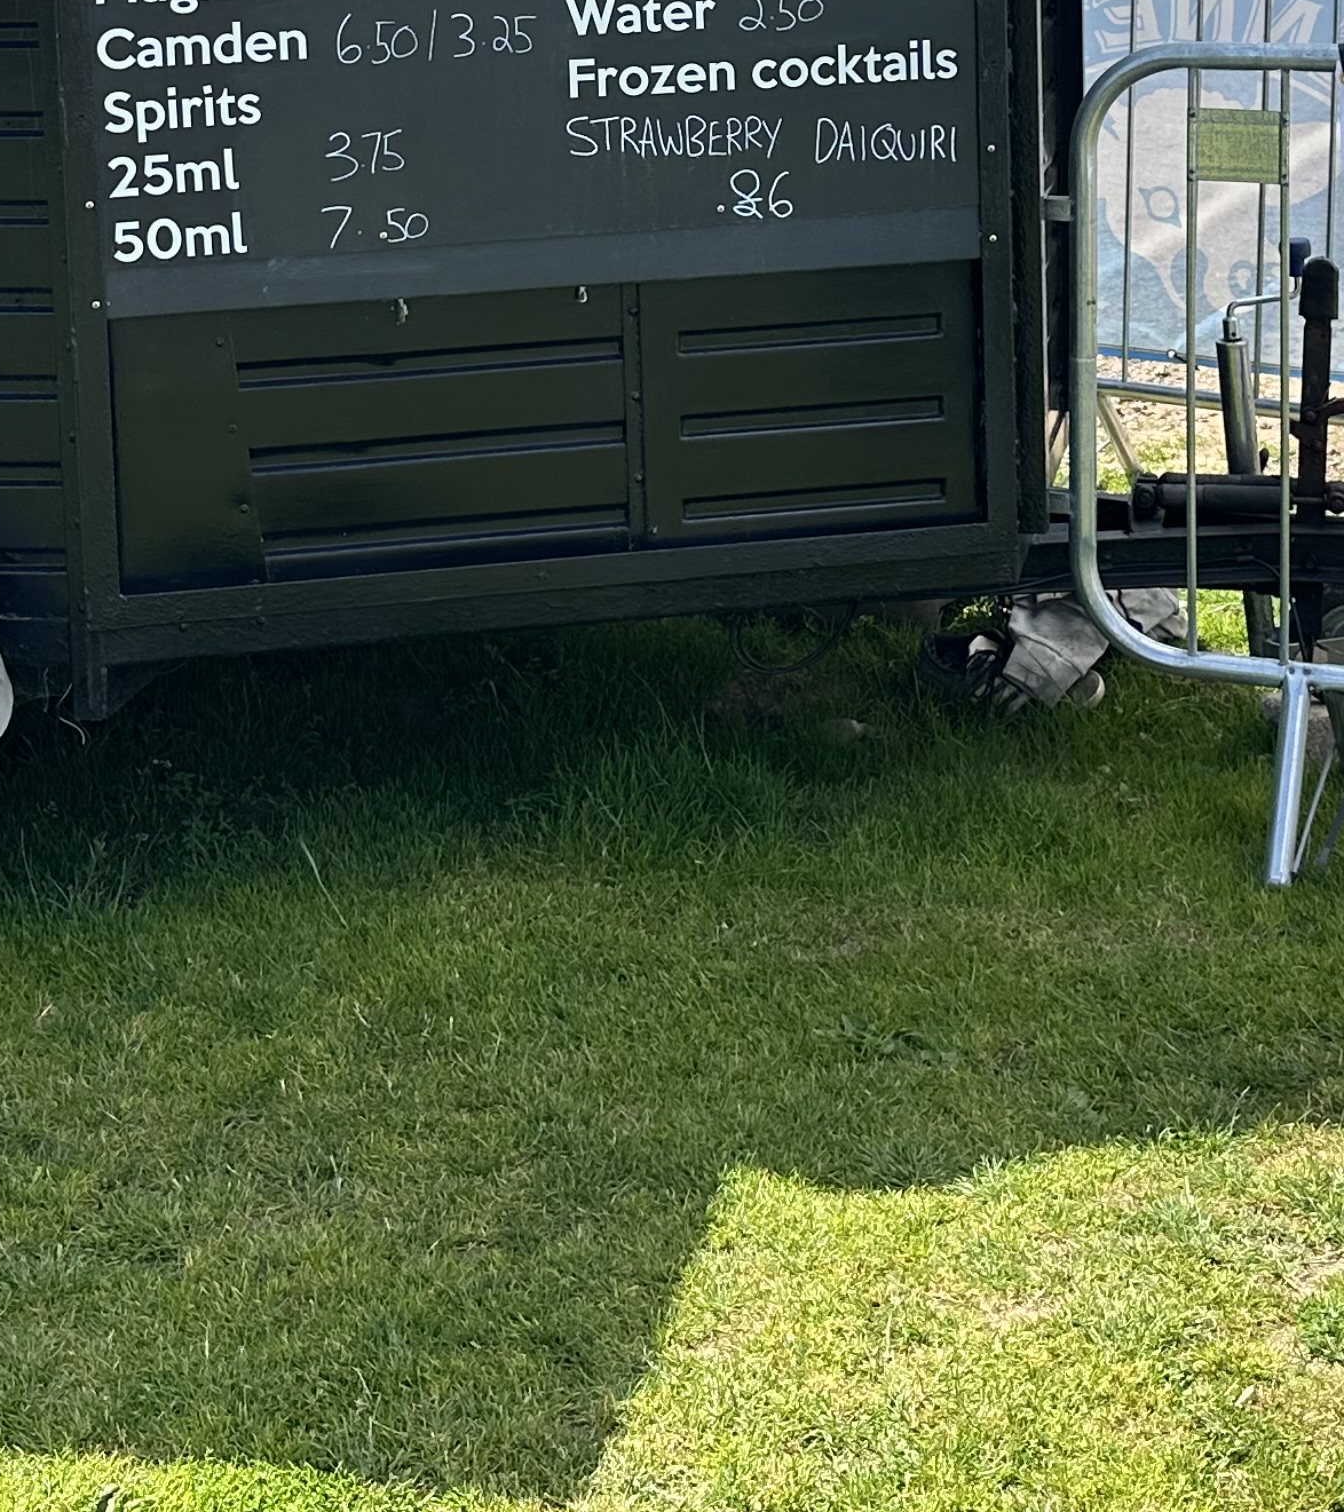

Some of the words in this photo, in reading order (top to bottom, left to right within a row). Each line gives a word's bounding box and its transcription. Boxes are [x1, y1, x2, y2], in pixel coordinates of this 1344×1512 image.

[96, 21, 308, 70] Camden
[568, 58, 735, 99] Frozen
[752, 40, 958, 89] cocktails
[103, 86, 262, 143] Spirits
[566, 115, 783, 159] STRAWBERRY
[814, 117, 957, 164] DAIQUIRI
[107, 148, 239, 199] 25ml
[113, 211, 248, 263] 50ml
